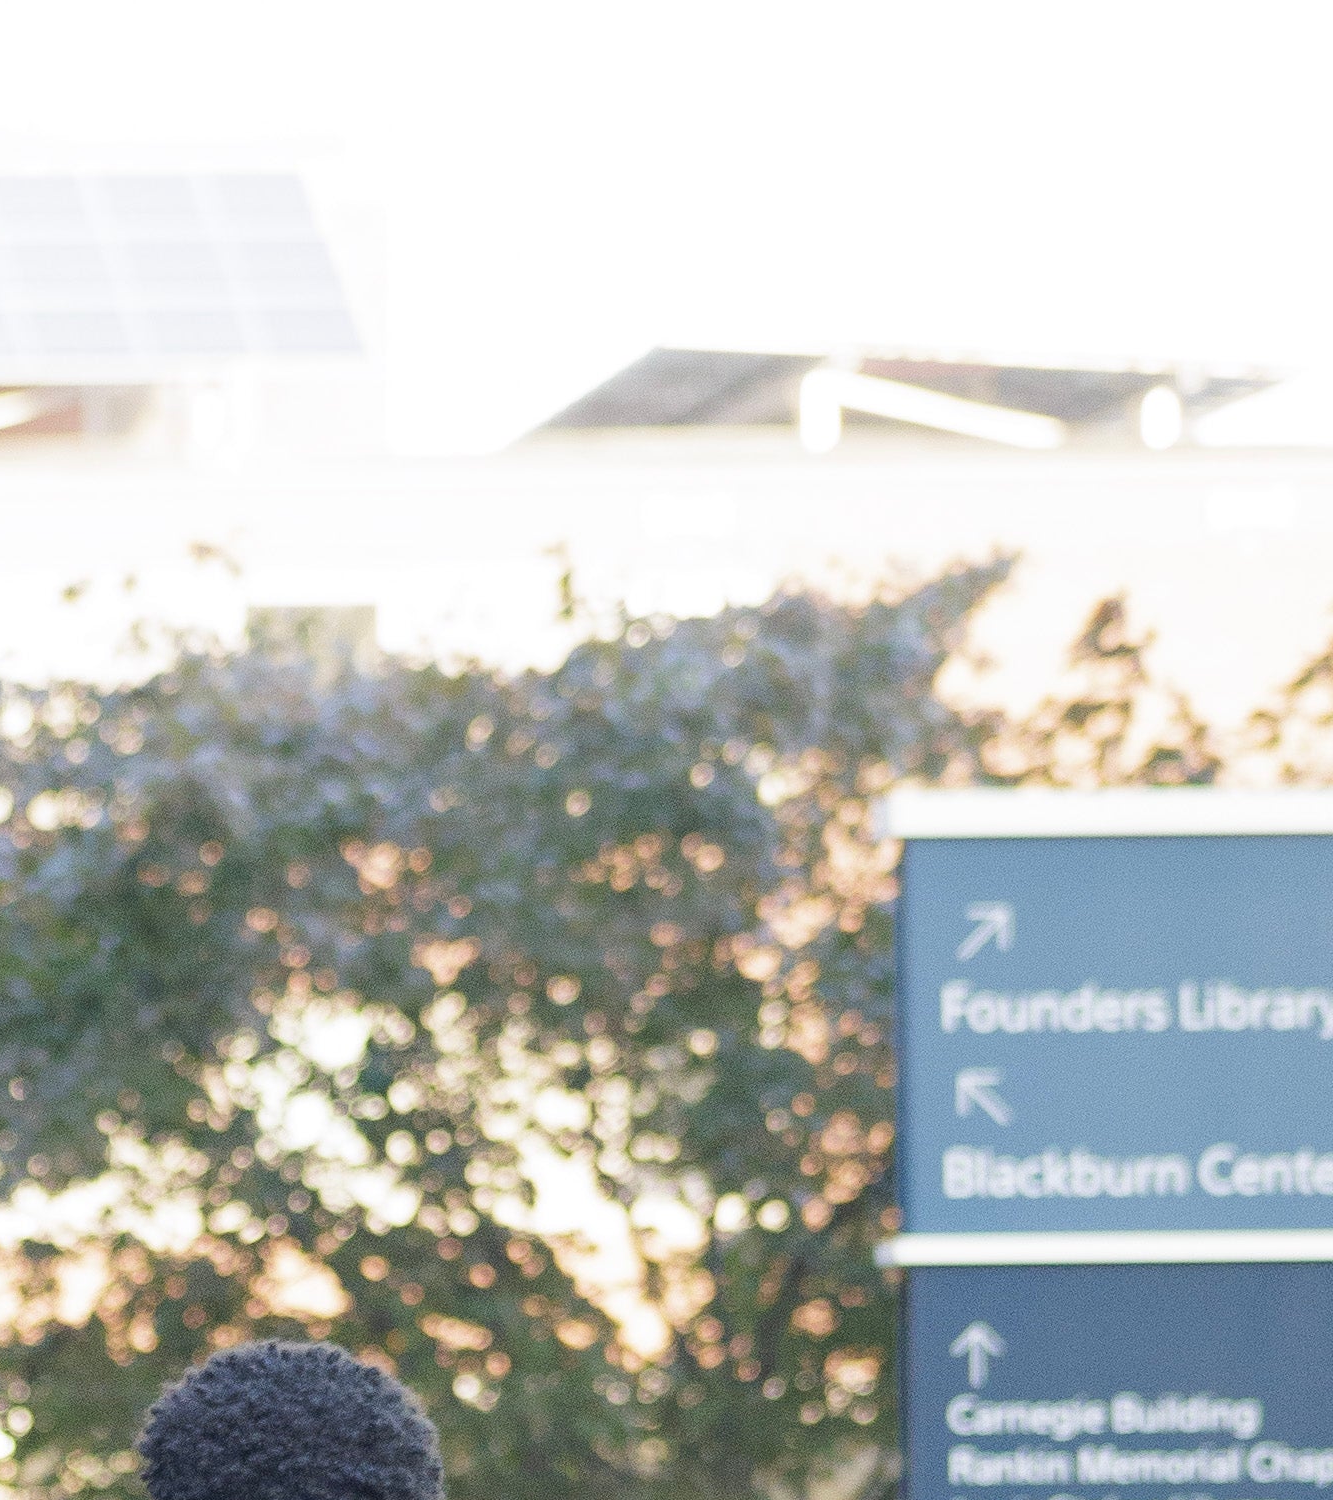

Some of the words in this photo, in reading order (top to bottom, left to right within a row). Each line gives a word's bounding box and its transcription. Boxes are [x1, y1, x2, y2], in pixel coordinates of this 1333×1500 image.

[940, 981, 1169, 1032] Founders
[942, 1145, 1190, 1198] Blackburn
[946, 1394, 1106, 1440] Carnegie
[1111, 1392, 1263, 1440] Building
[948, 1445, 1070, 1485] Rankin
[1076, 1444, 1237, 1484] Memorial
